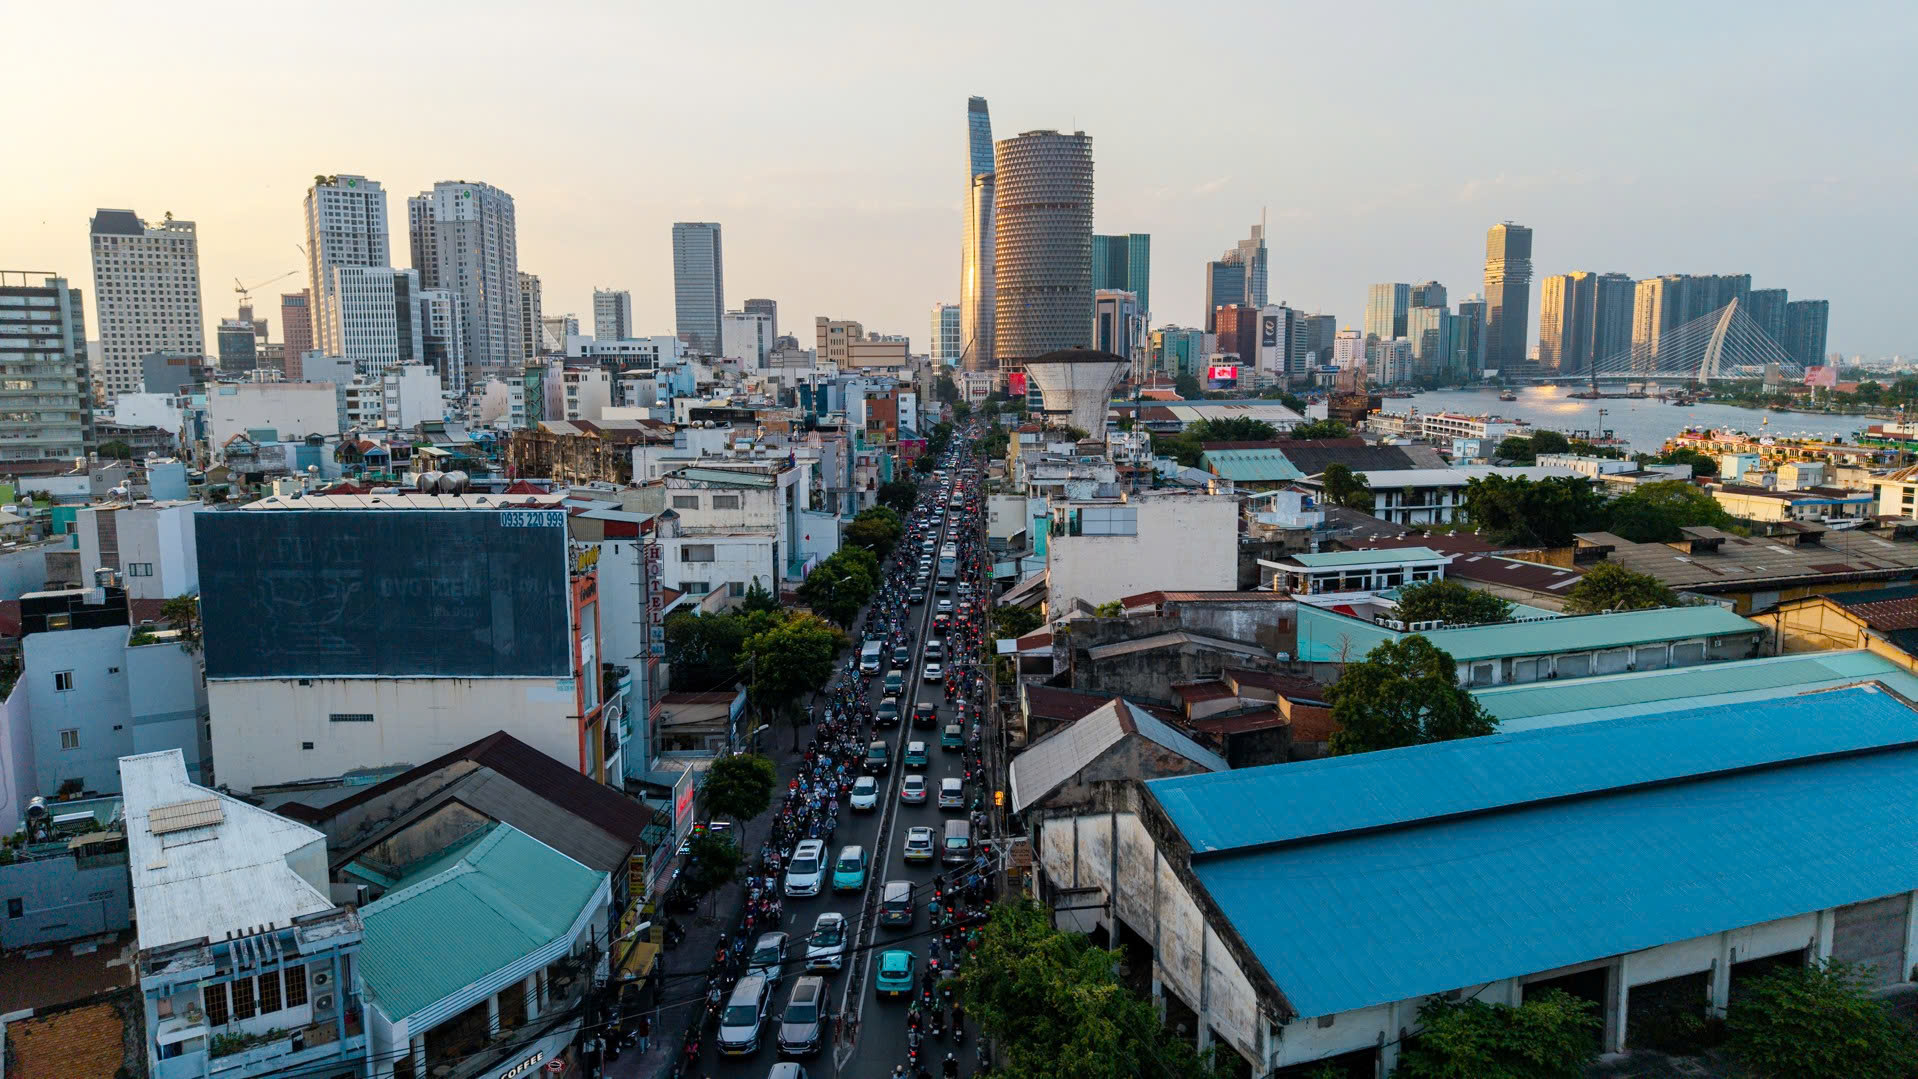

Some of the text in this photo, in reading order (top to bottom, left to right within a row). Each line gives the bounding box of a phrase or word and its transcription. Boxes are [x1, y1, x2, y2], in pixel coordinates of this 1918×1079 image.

[501, 512, 564, 527] 0935 220 999
[650, 548, 661, 623] HOTEL
[501, 1051, 544, 1079] COFFEE
